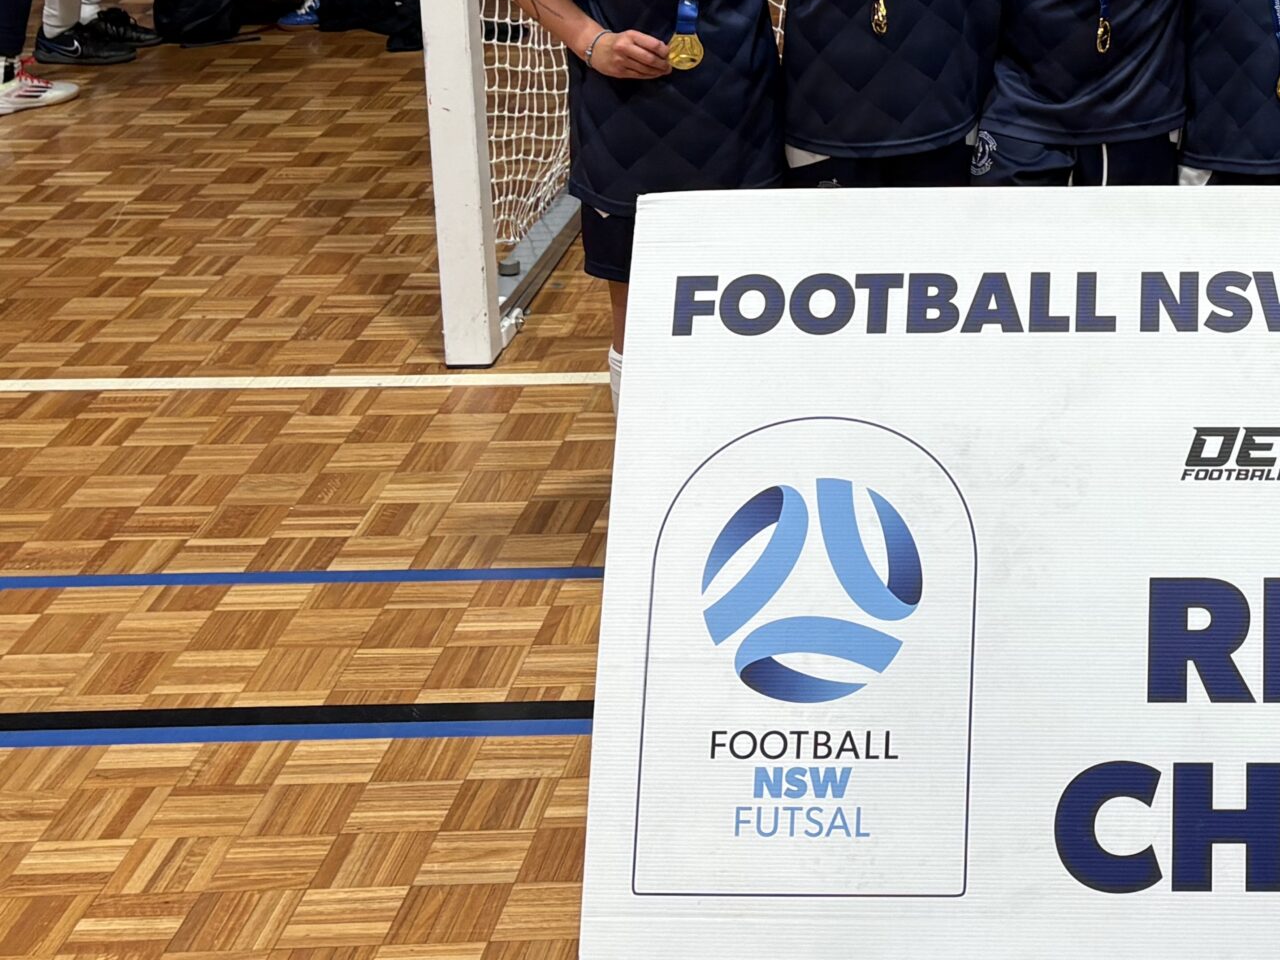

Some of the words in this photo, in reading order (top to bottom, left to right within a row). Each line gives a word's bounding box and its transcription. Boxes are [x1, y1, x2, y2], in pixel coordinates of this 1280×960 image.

[672, 271, 1117, 337] FOOTBALL
[710, 730, 899, 760] FOOTBALL
[753, 767, 852, 799] NSW
[734, 806, 870, 837] FUTSAL
